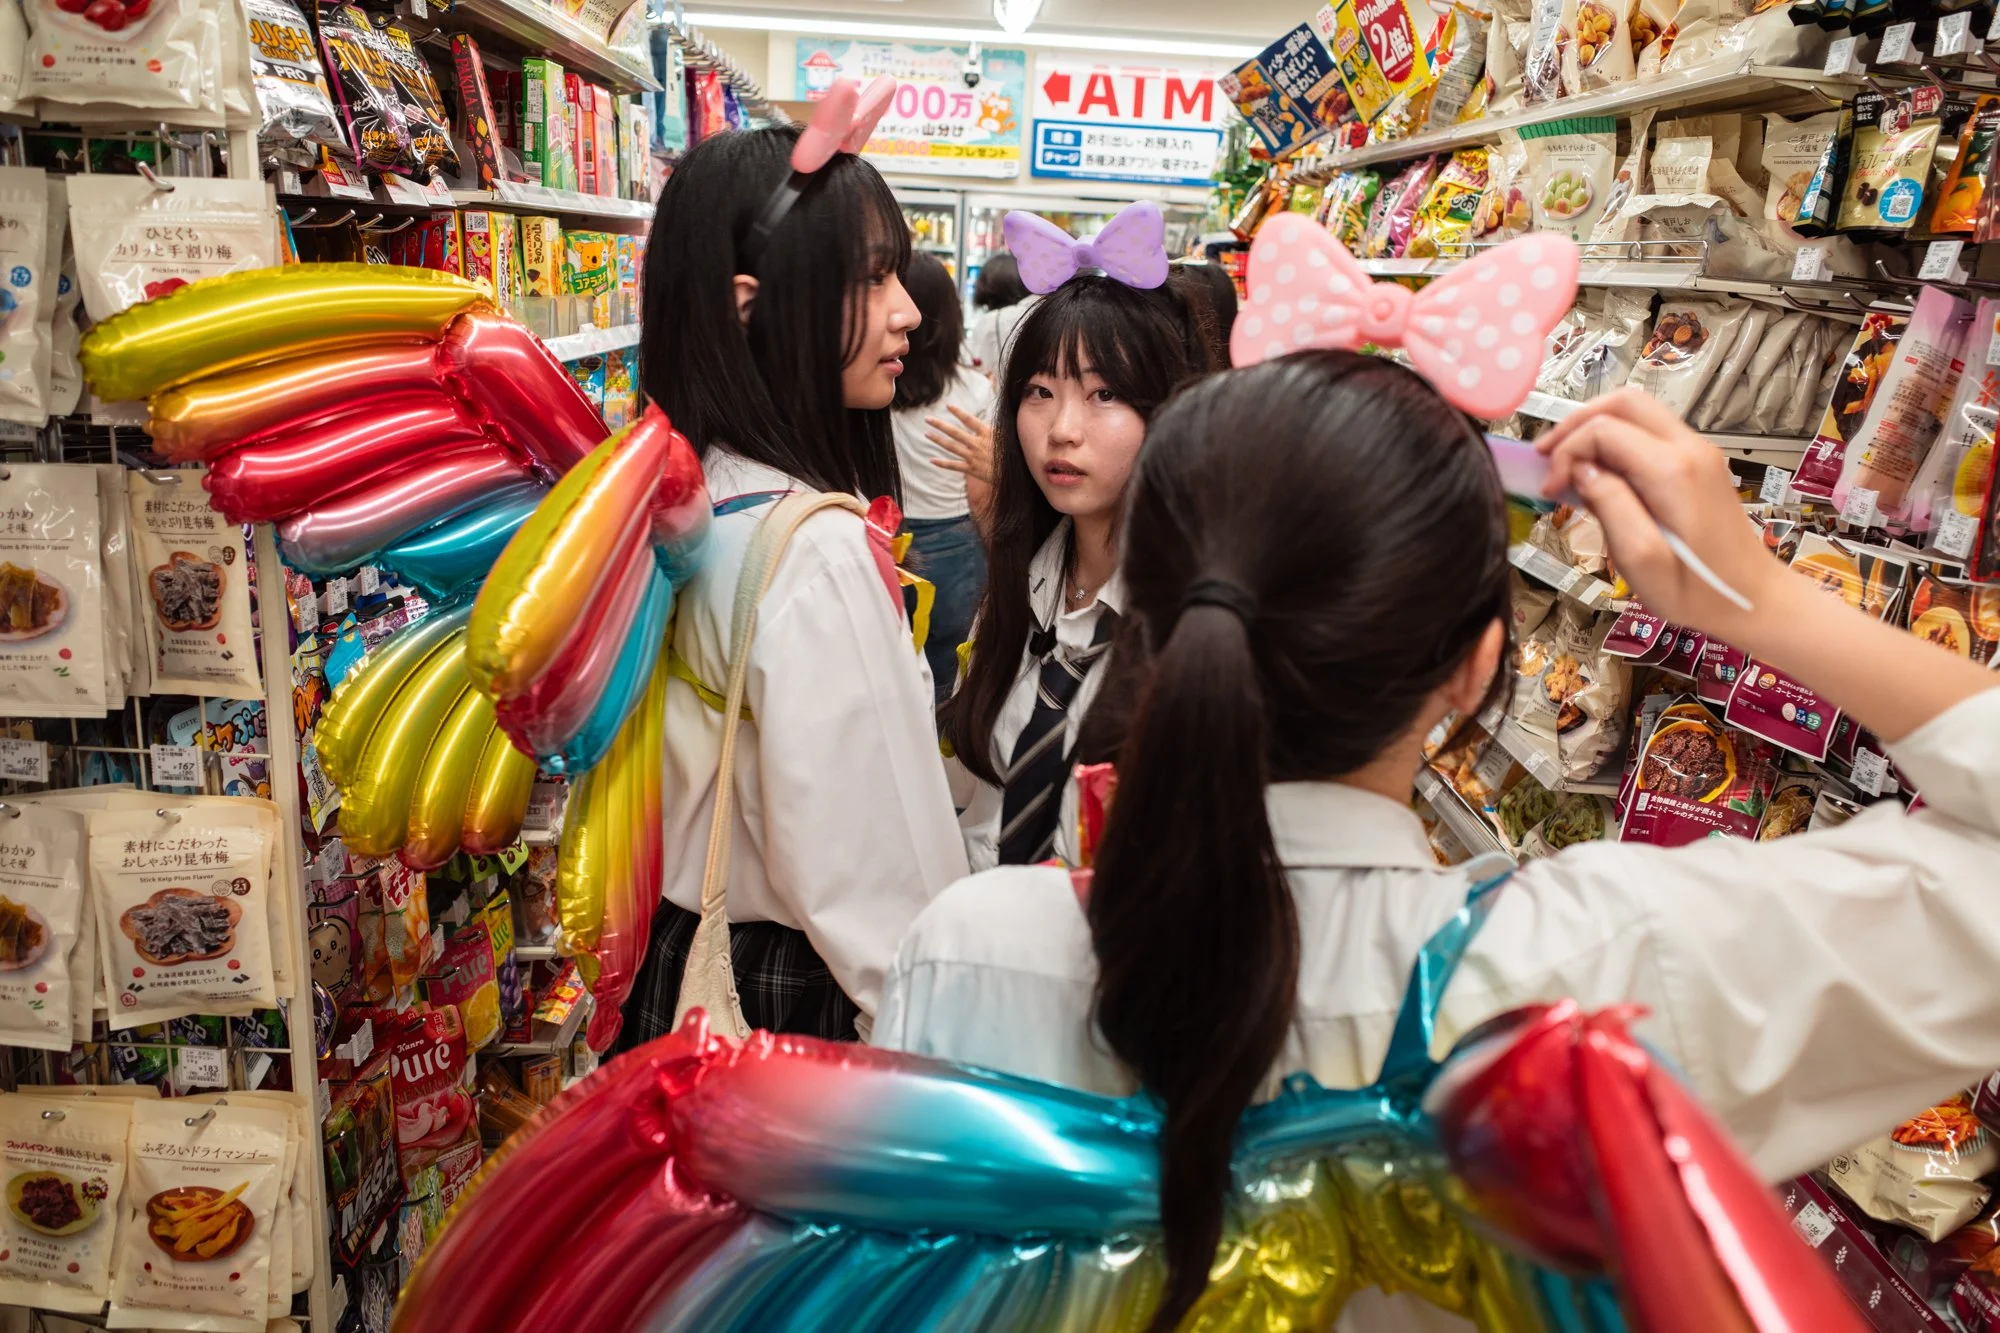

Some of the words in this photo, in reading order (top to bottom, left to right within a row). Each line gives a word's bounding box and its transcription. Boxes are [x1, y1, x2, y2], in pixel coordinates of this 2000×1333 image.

[274, 64, 305, 81] PRO
[523, 64, 544, 73] プリッツ
[1275, 47, 1316, 89] 香ばしい
[895, 84, 974, 120] 00万
[1078, 73, 1214, 122] ATM
[146, 227, 199, 242] ひとくち
[115, 243, 233, 260] カリッと手割り梅
[534, 223, 545, 264] きのこの山
[144, 501, 212, 514] 素材にこだわった
[1776, 686, 1817, 706] コーヒーナッツ
[177, 717, 198, 731] LOTTE
[1651, 795, 1723, 818] 食物繊維と鉄分が摂れる
[1647, 803, 1733, 831] オートミールのチョコフレーク
[124, 836, 228, 853] 素材にこだわった
[121, 852, 230, 869] おしゃぶり昆布梅
[157, 876, 171, 884] Kelp
[192, 873, 214, 881] Flavor
[233, 883, 247, 891] 2.1
[156, 968, 217, 979] 北海道根室産昆布と
[396, 1039, 424, 1054] Kanro
[390, 1036, 451, 1083] Puré
[142, 1143, 269, 1160] ふぞろいドライマンゴー
[76, 1164, 91, 1172] Dried
[92, 1166, 108, 1174] Plum
[182, 1165, 199, 1173] Dried
[200, 1166, 221, 1174] Mango
